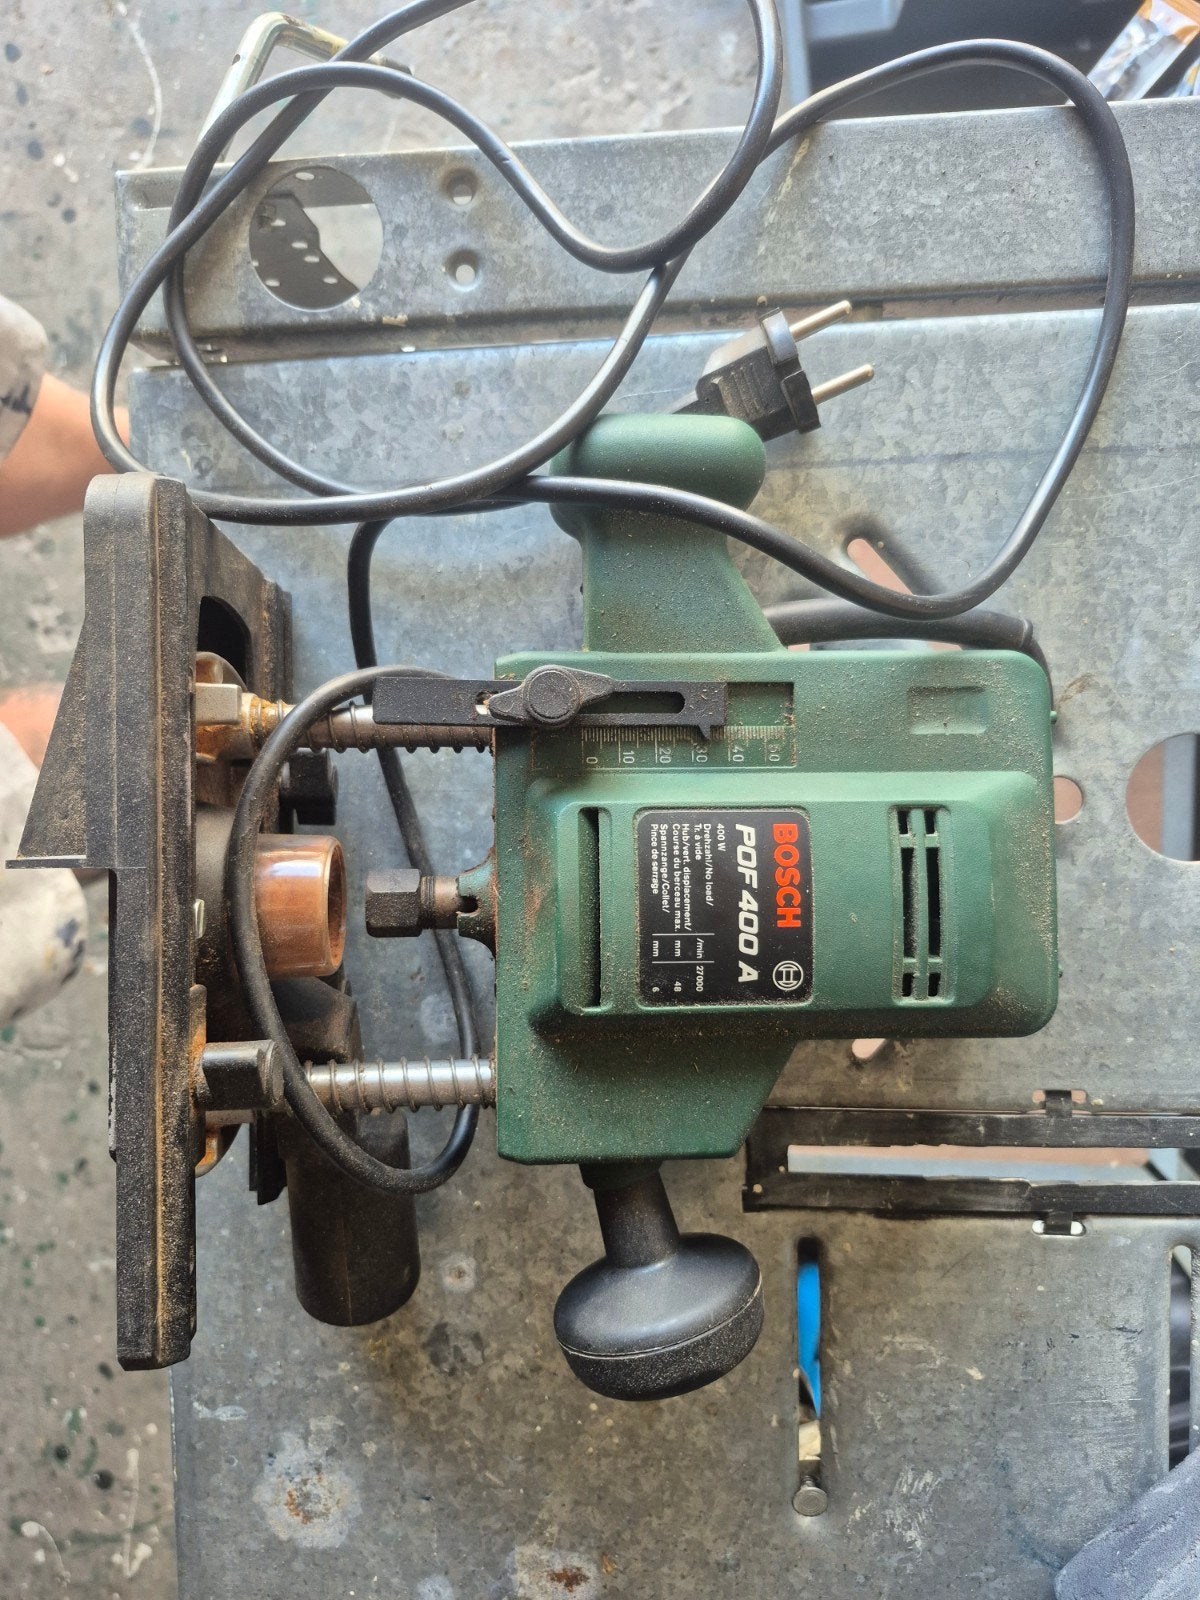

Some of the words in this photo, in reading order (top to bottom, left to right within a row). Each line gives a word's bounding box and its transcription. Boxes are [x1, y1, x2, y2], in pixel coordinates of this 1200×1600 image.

[586, 756, 599, 765] 0
[622, 750, 635, 764] 10
[658, 748, 672, 764] 20
[695, 745, 708, 763] 30
[732, 745, 745, 763] 40
[650, 823, 659, 847] Pince
[694, 823, 703, 833] Tr.
[716, 823, 726, 841] 400
[672, 823, 681, 856] Course
[681, 823, 691, 865] Hub/vert.
[717, 842, 727, 852] W
[651, 848, 660, 860] de
[694, 842, 703, 861] vide
[703, 823, 714, 880] Drehzahl/No
[735, 823, 758, 889] POF
[659, 823, 671, 913] Spannzange/Collet/
[673, 857, 682, 869] du
[650, 861, 659, 895] serrage
[772, 823, 802, 928] BOSCH
[673, 871, 682, 908] berceau
[682, 866, 692, 931] displacement/
[705, 881, 715, 907] load/
[738, 889, 759, 956] 400
[652, 940, 659, 957] mm
[674, 940, 681, 957] mm
[696, 937, 705, 959] /min
[695, 965, 704, 992] 27000
[738, 960, 759, 983] A
[673, 980, 682, 992] 48
